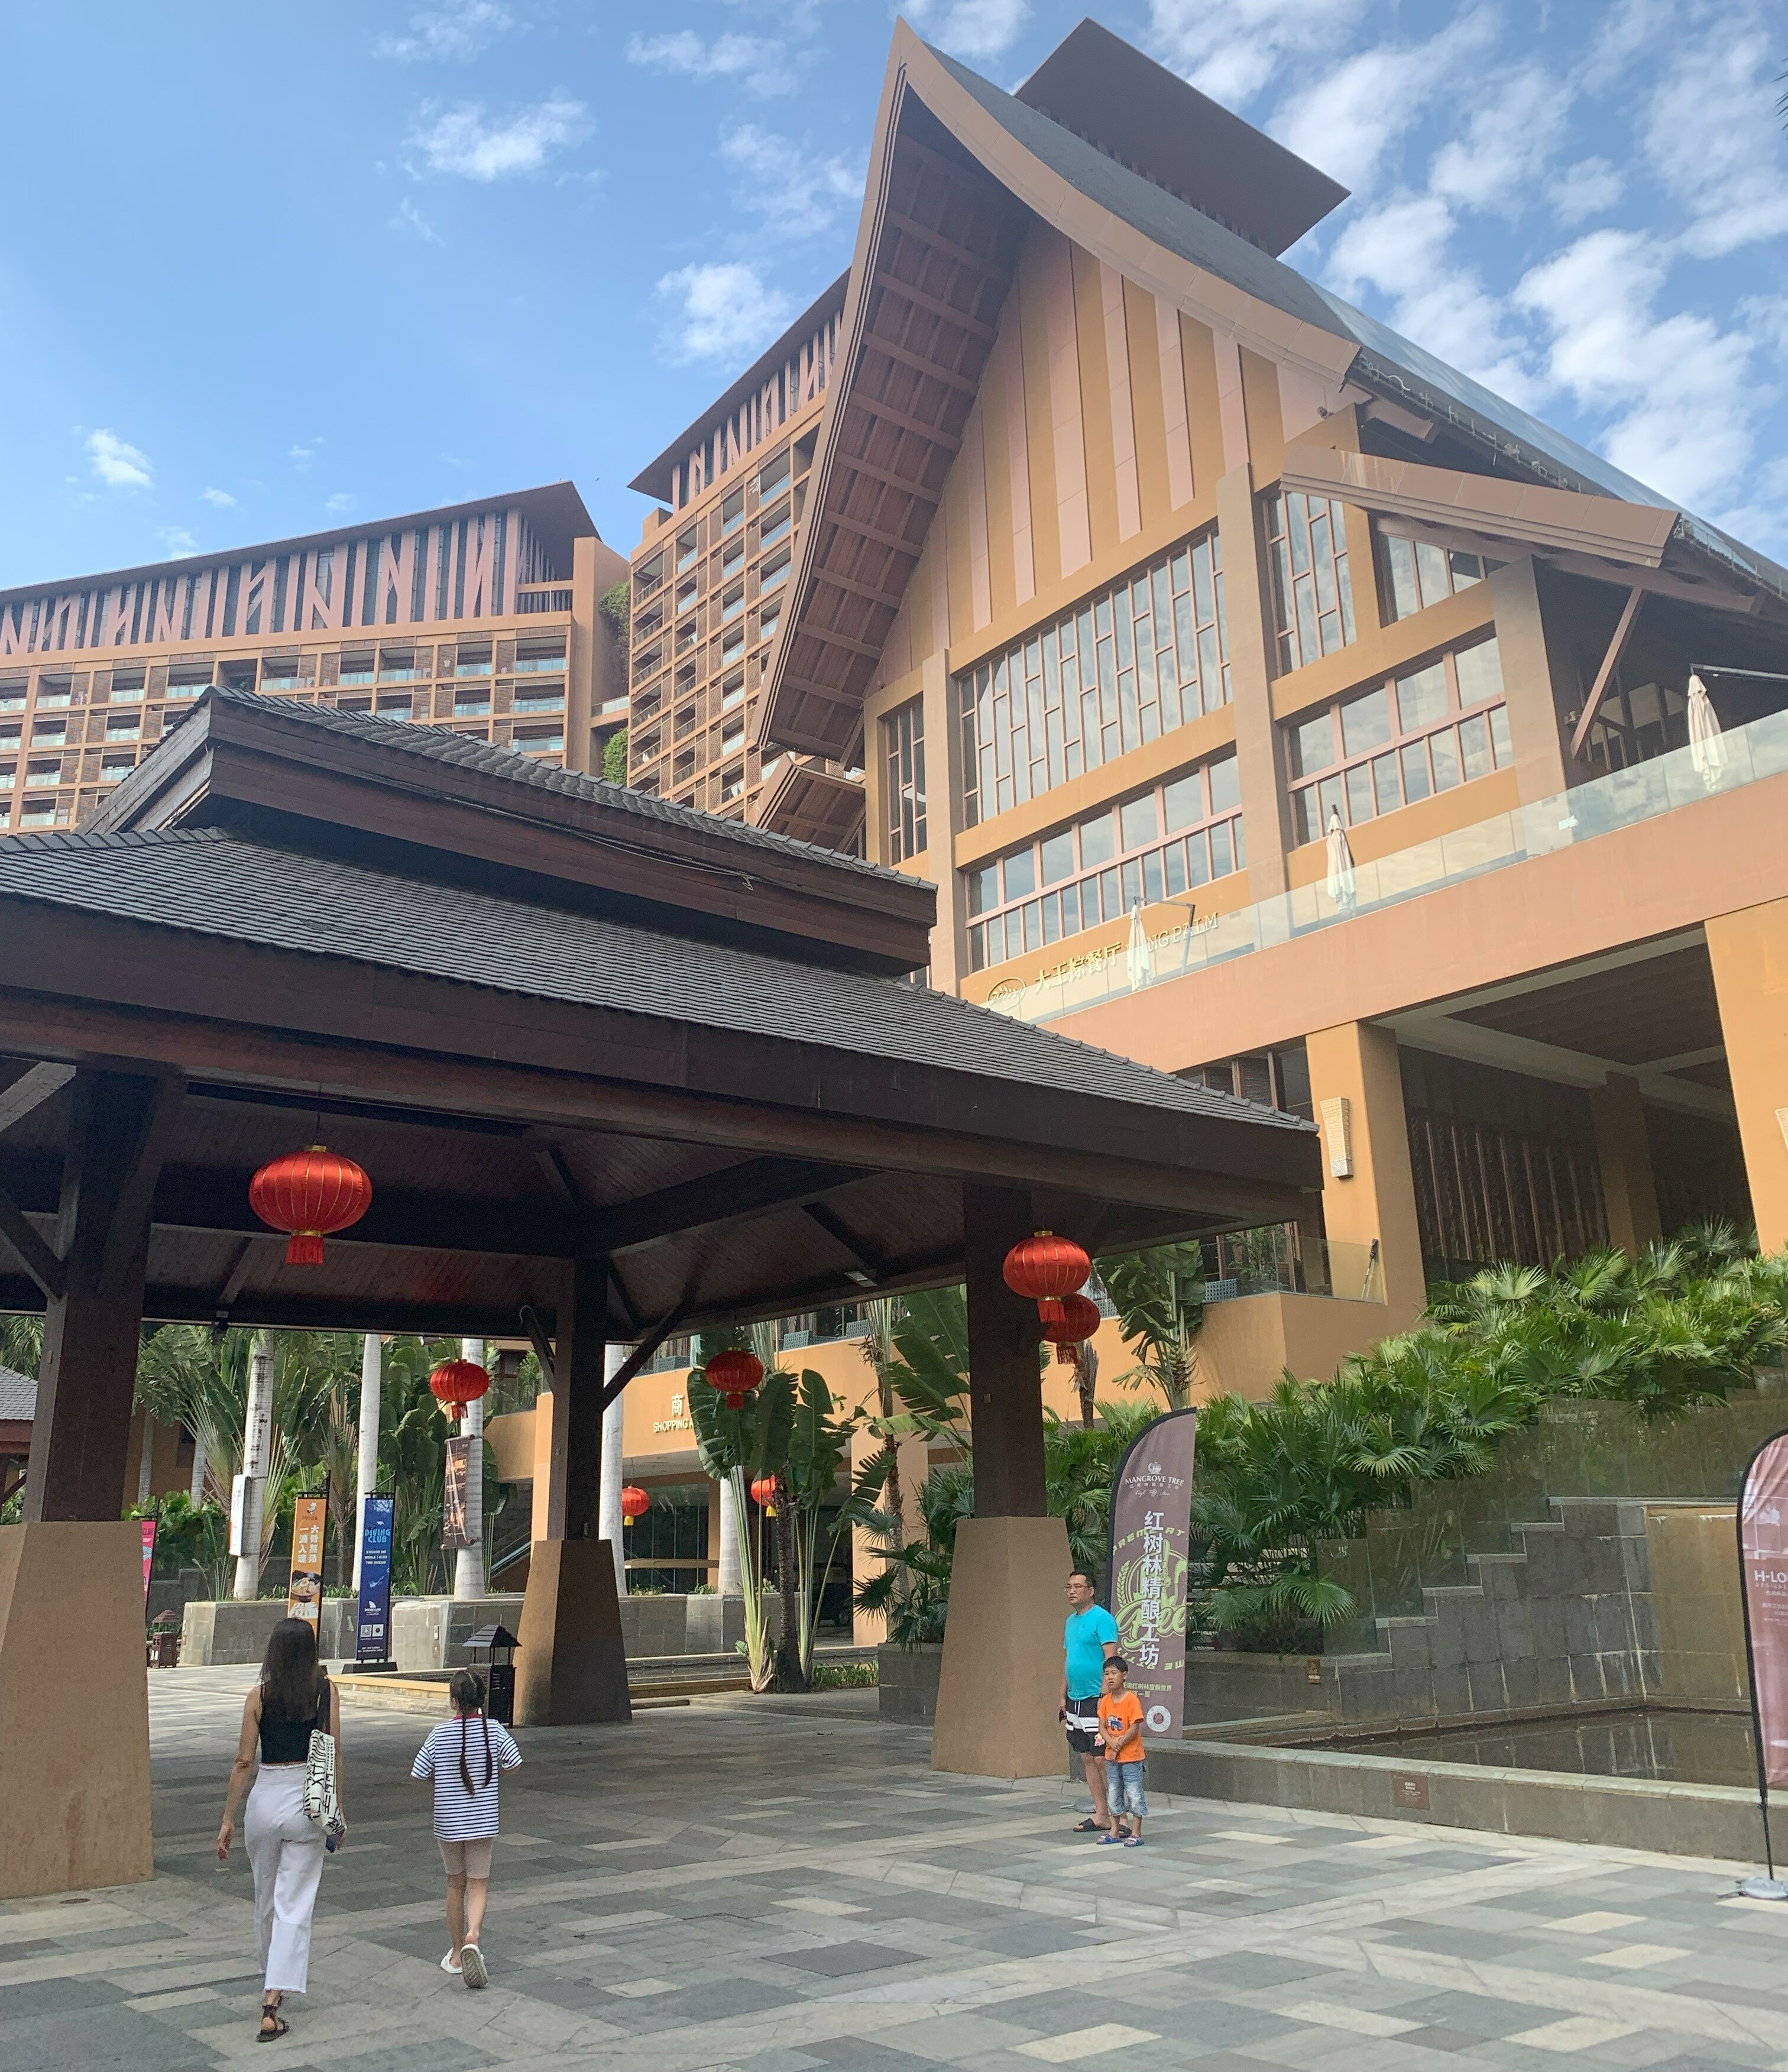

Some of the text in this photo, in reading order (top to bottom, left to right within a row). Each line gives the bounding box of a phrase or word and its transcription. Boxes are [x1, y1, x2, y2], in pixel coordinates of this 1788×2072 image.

[1172, 912, 1220, 943] PALM
[1035, 941, 1121, 995] 大王棕餐厅
[653, 1418, 689, 1433] SHOPPING
[1125, 1475, 1184, 1486] MANGROVE TREE
[364, 1528, 391, 1536] DIVING
[1139, 1510, 1164, 1666] 红树林精酿工坊
